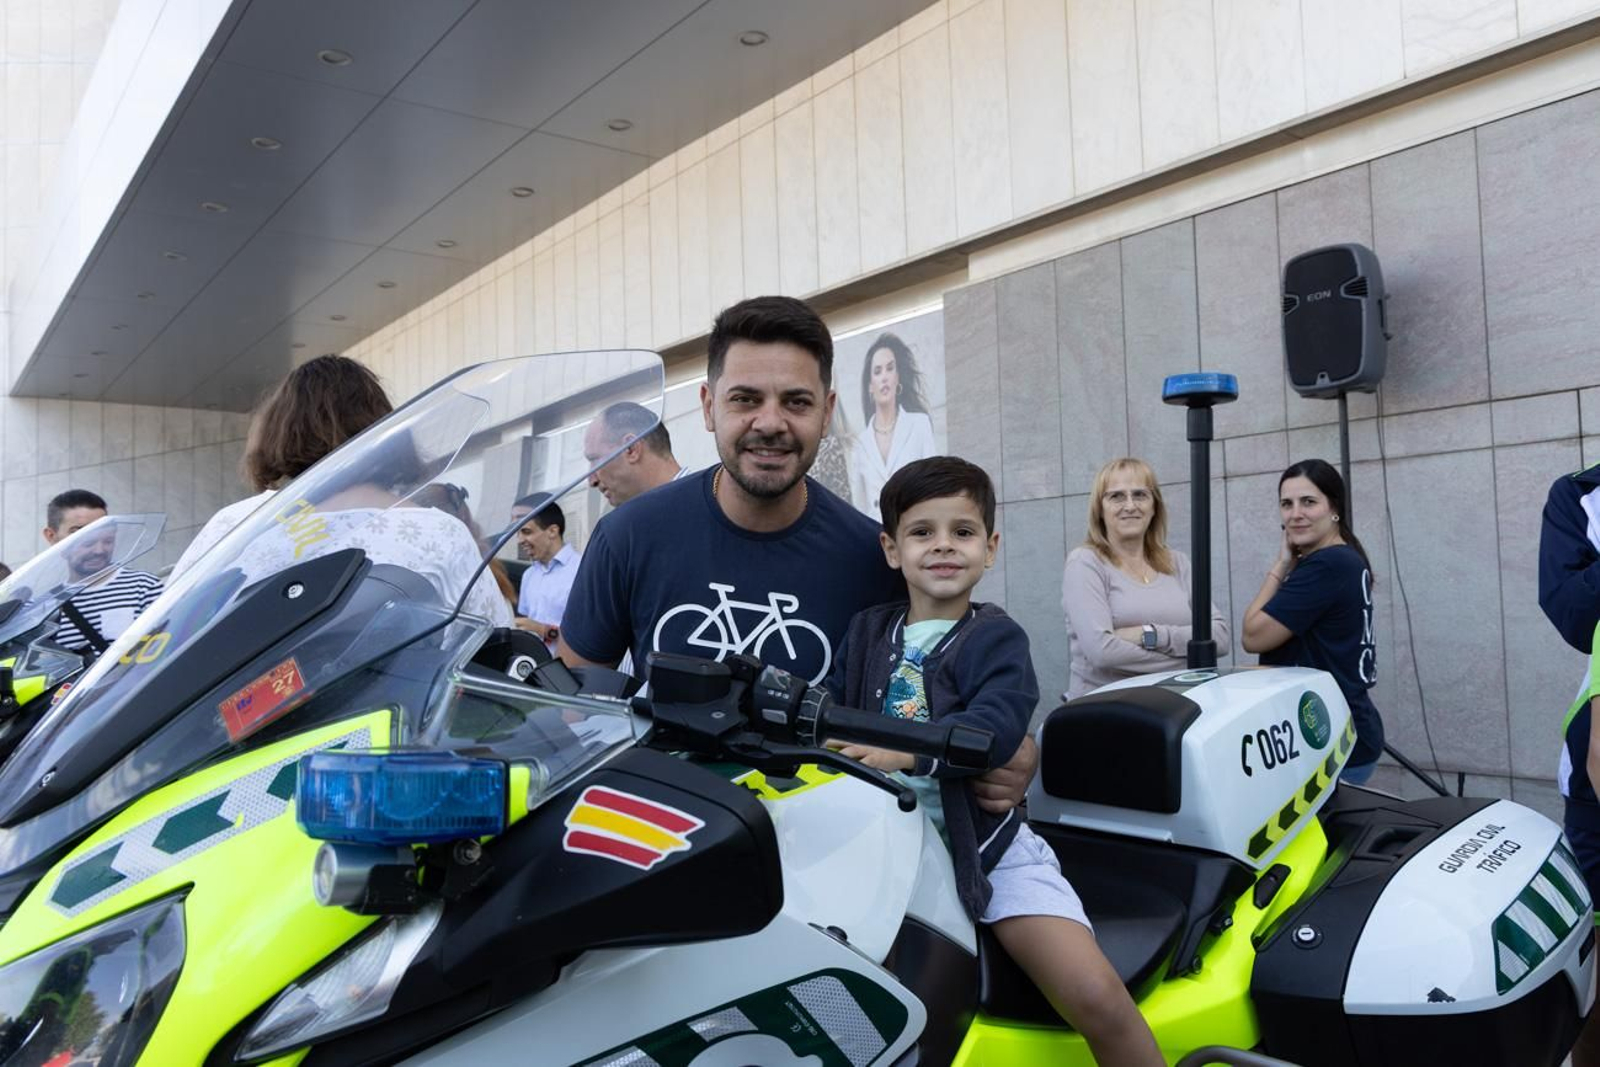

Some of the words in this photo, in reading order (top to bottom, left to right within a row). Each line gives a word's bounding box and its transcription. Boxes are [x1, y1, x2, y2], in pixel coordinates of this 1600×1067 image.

[1306, 290, 1332, 302] EON
[271, 669, 295, 695] 27
[1256, 719, 1300, 770] 062
[1438, 838, 1488, 874] GUARDIA
[1476, 823, 1506, 840] CIVIL
